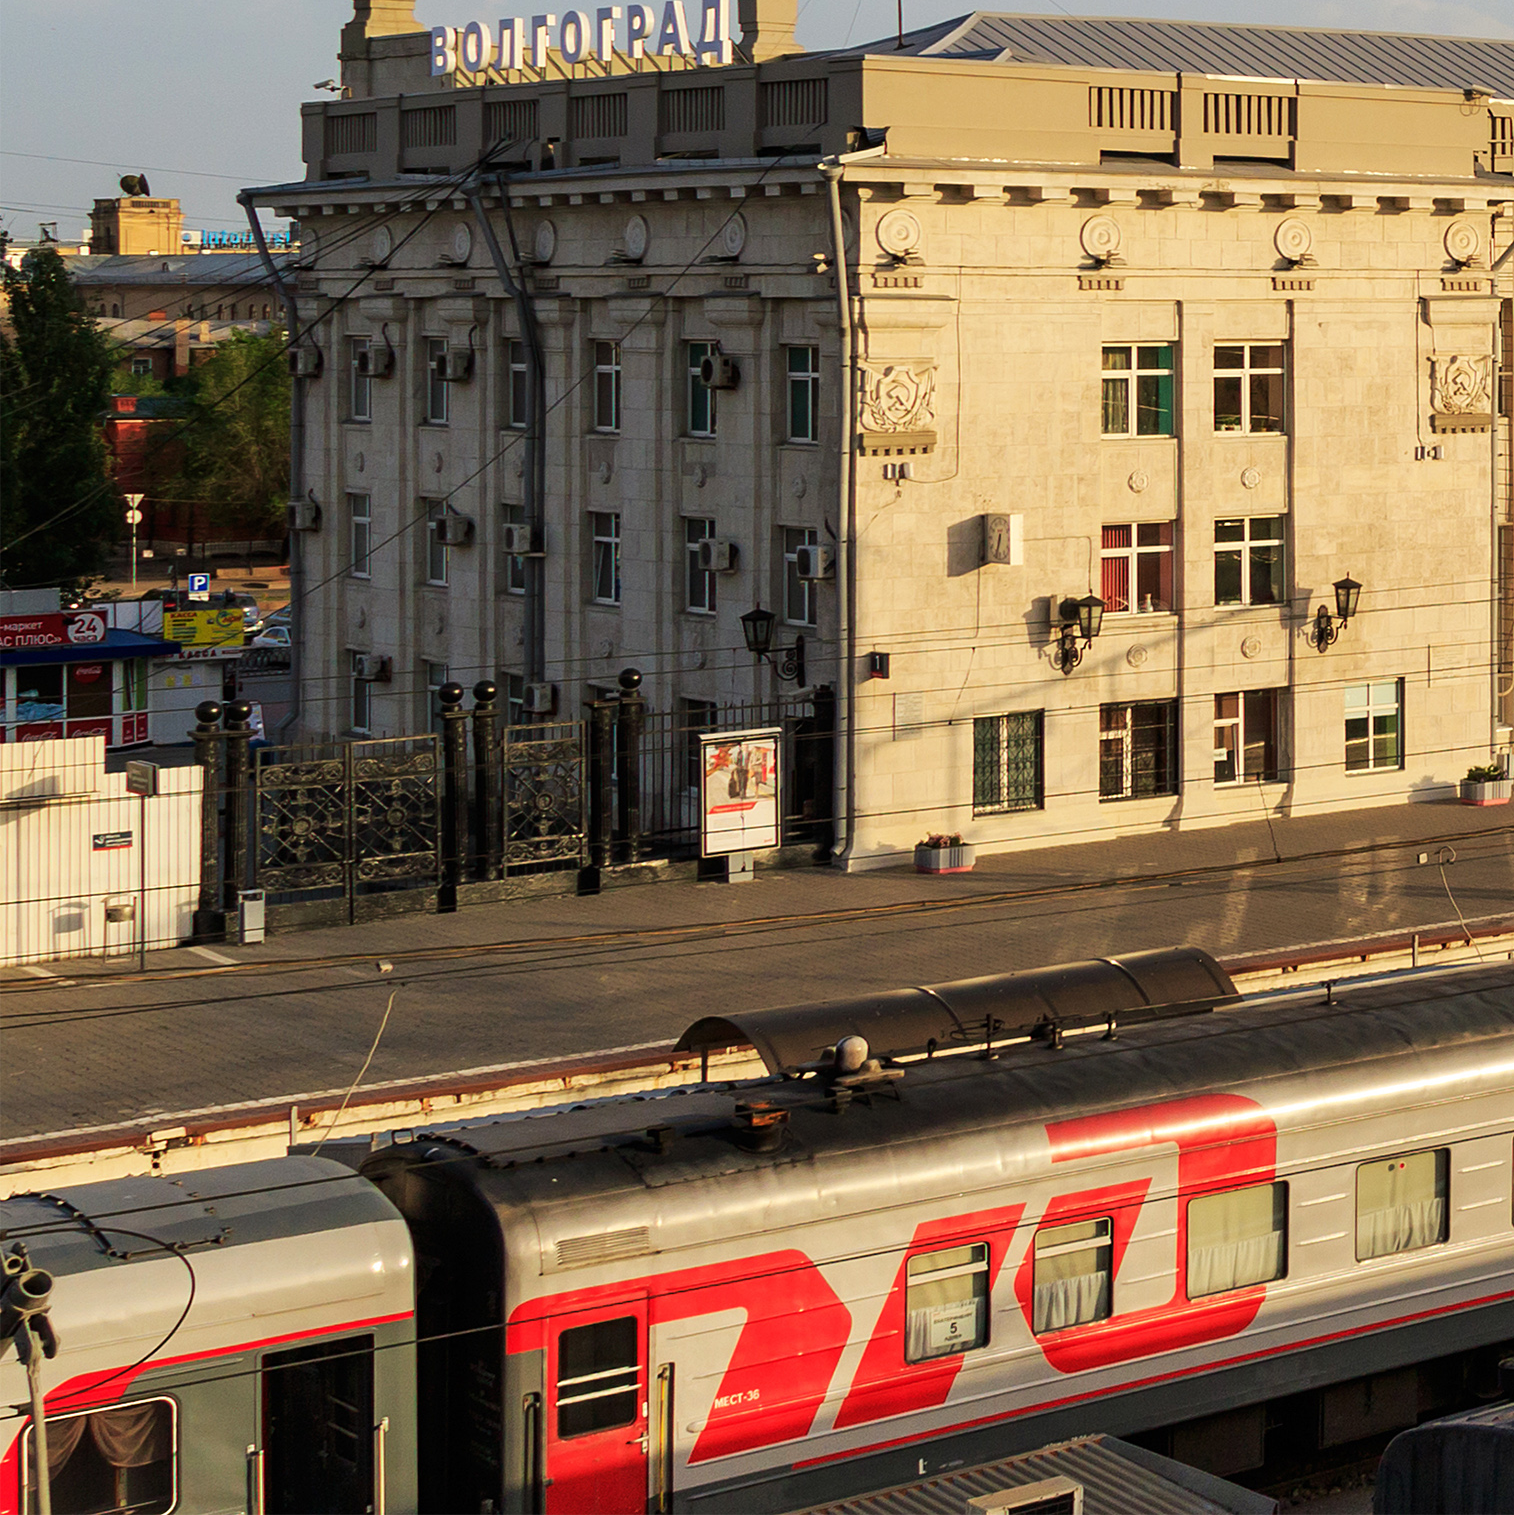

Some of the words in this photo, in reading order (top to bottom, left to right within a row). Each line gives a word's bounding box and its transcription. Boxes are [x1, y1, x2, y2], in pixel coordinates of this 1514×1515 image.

[194, 576, 206, 591] P
[75, 617, 98, 635] 24
[178, 649, 217, 659] КАССА
[950, 1321, 958, 1334] 5
[714, 1388, 760, 1410] МЕСТ-36
